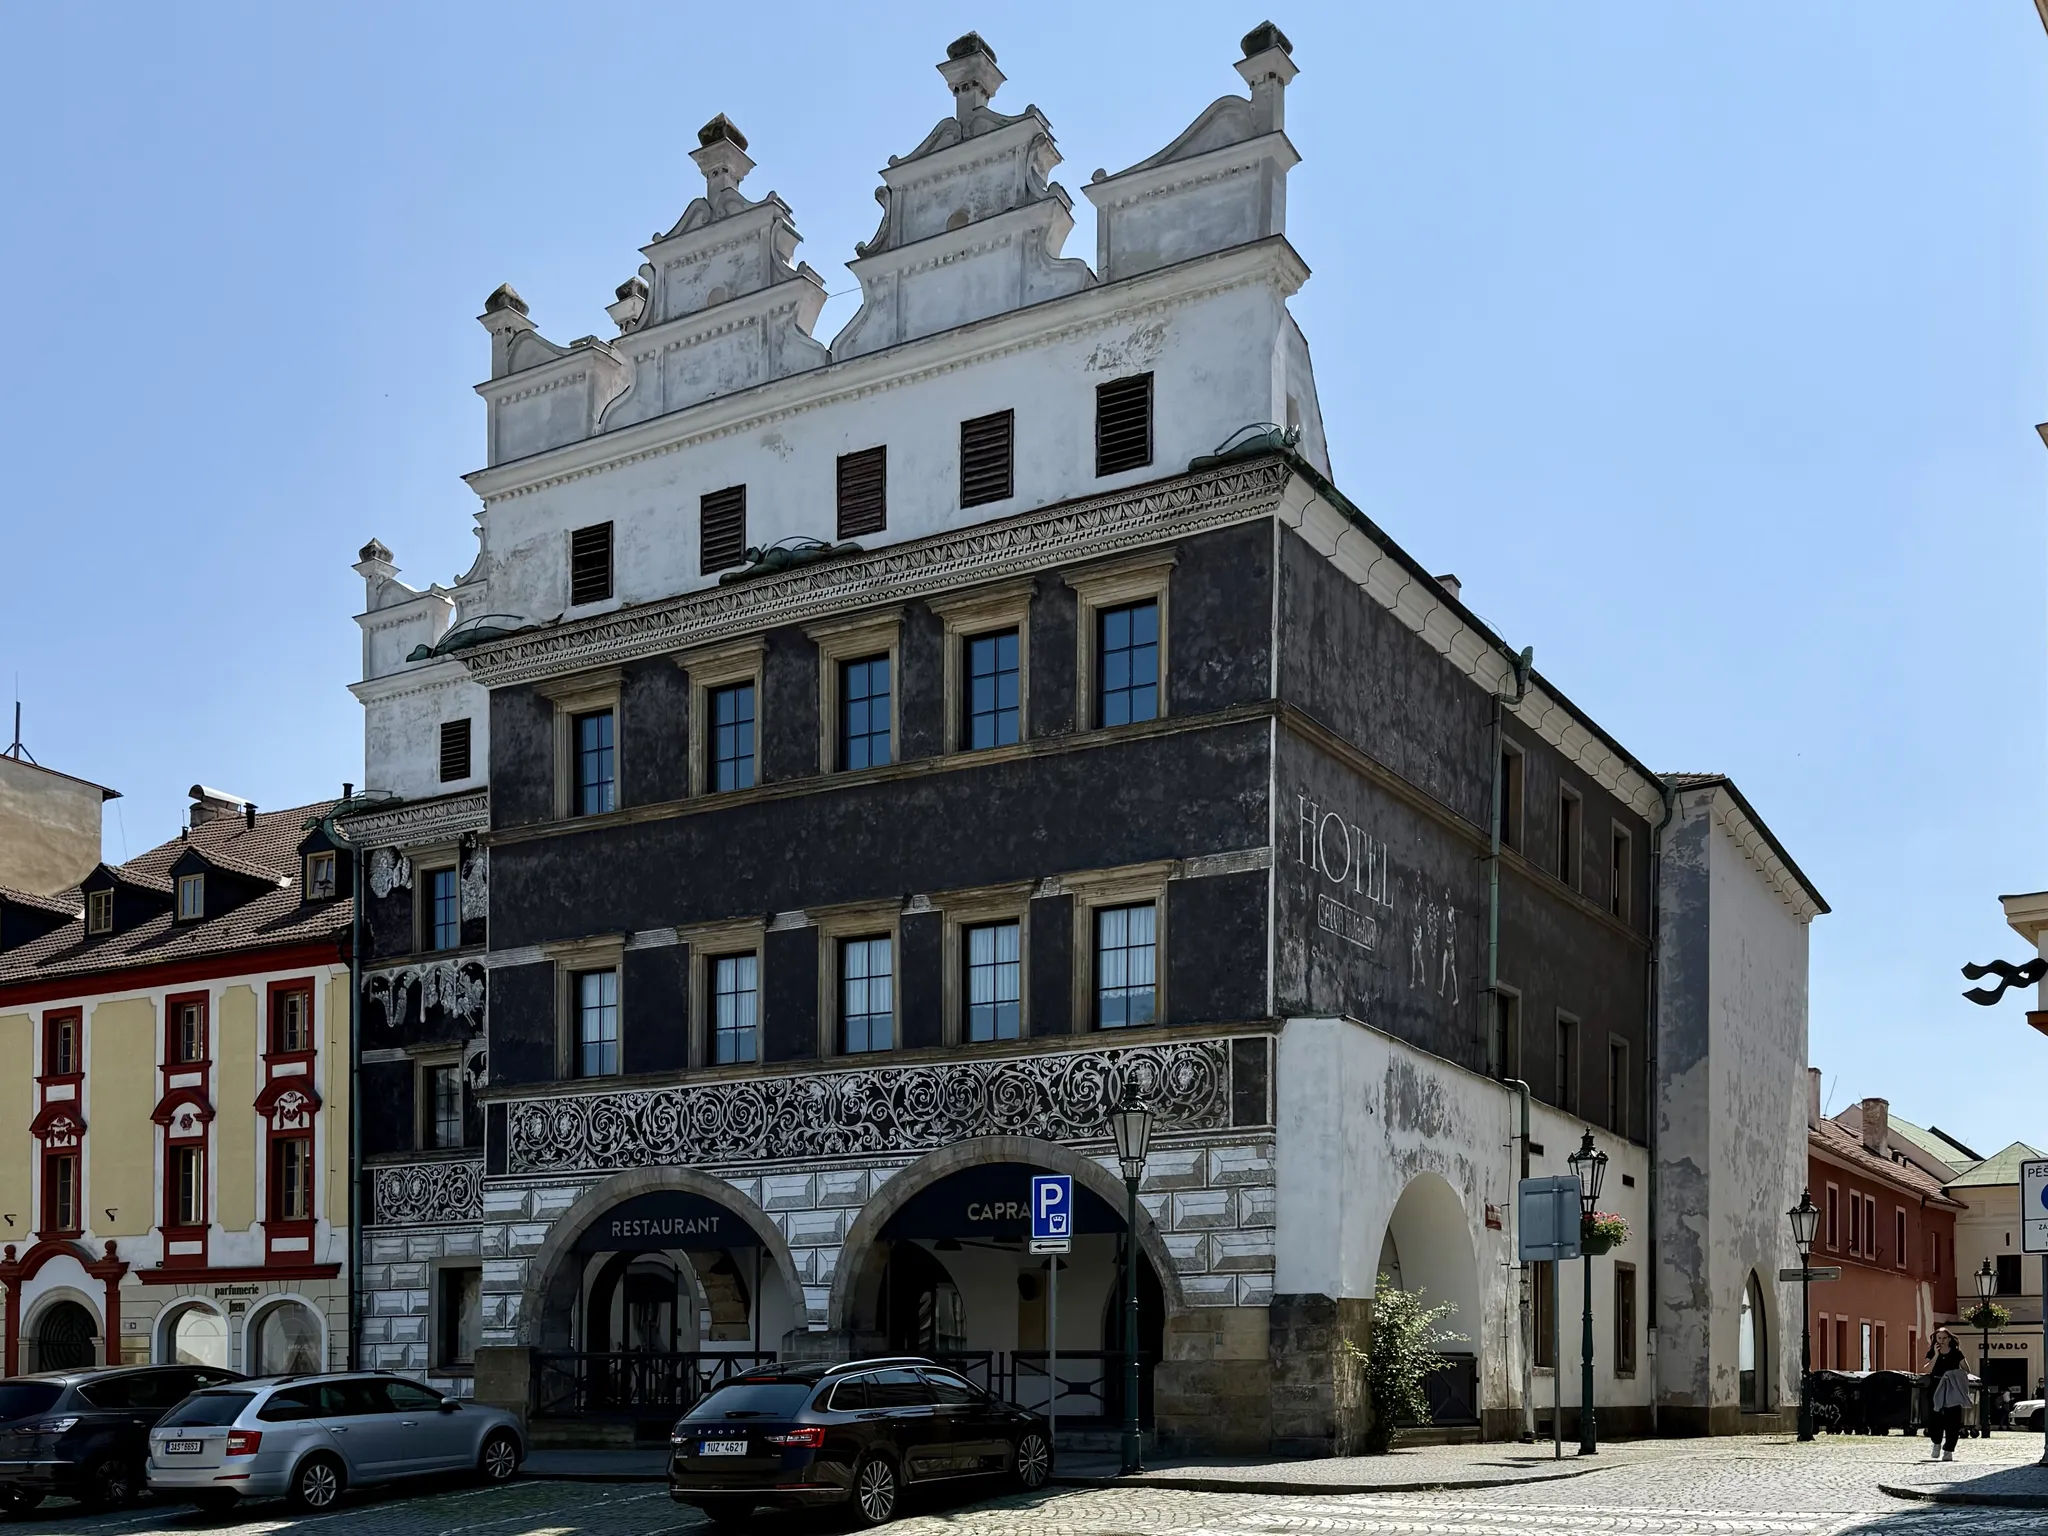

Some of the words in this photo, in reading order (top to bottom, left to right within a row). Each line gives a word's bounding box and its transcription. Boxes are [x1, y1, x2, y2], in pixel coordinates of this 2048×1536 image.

[1296, 793, 1394, 912] HOTEL
[967, 1201, 1032, 1220] CAPRA
[1040, 1183, 1063, 1219] P
[611, 1217, 720, 1237] RESTAURANT
[214, 1283, 260, 1299] parfumerie
[706, 1442, 720, 1453] 1UZ
[724, 1442, 744, 1453] 4621
